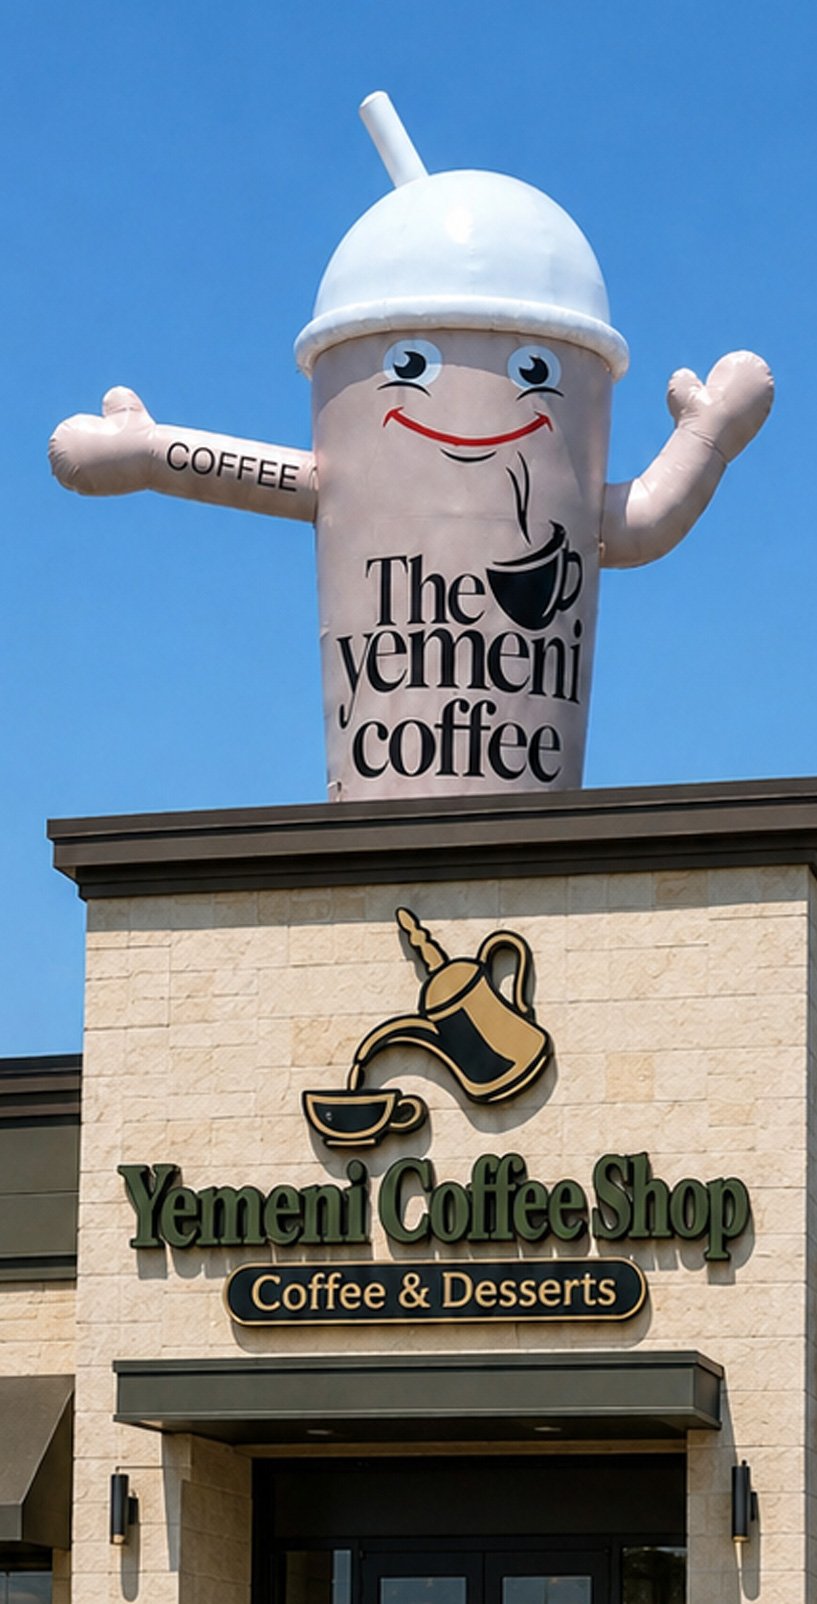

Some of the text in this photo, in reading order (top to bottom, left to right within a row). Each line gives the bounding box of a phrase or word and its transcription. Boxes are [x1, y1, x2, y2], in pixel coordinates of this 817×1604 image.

[167, 442, 299, 492] COFFEE
[365, 554, 486, 626] The
[336, 619, 582, 729] yemeni
[352, 698, 561, 782] coffee
[117, 1151, 751, 1262] Yemeni Coffee Shop
[251, 1271, 617, 1312] Coffee & Desserts
